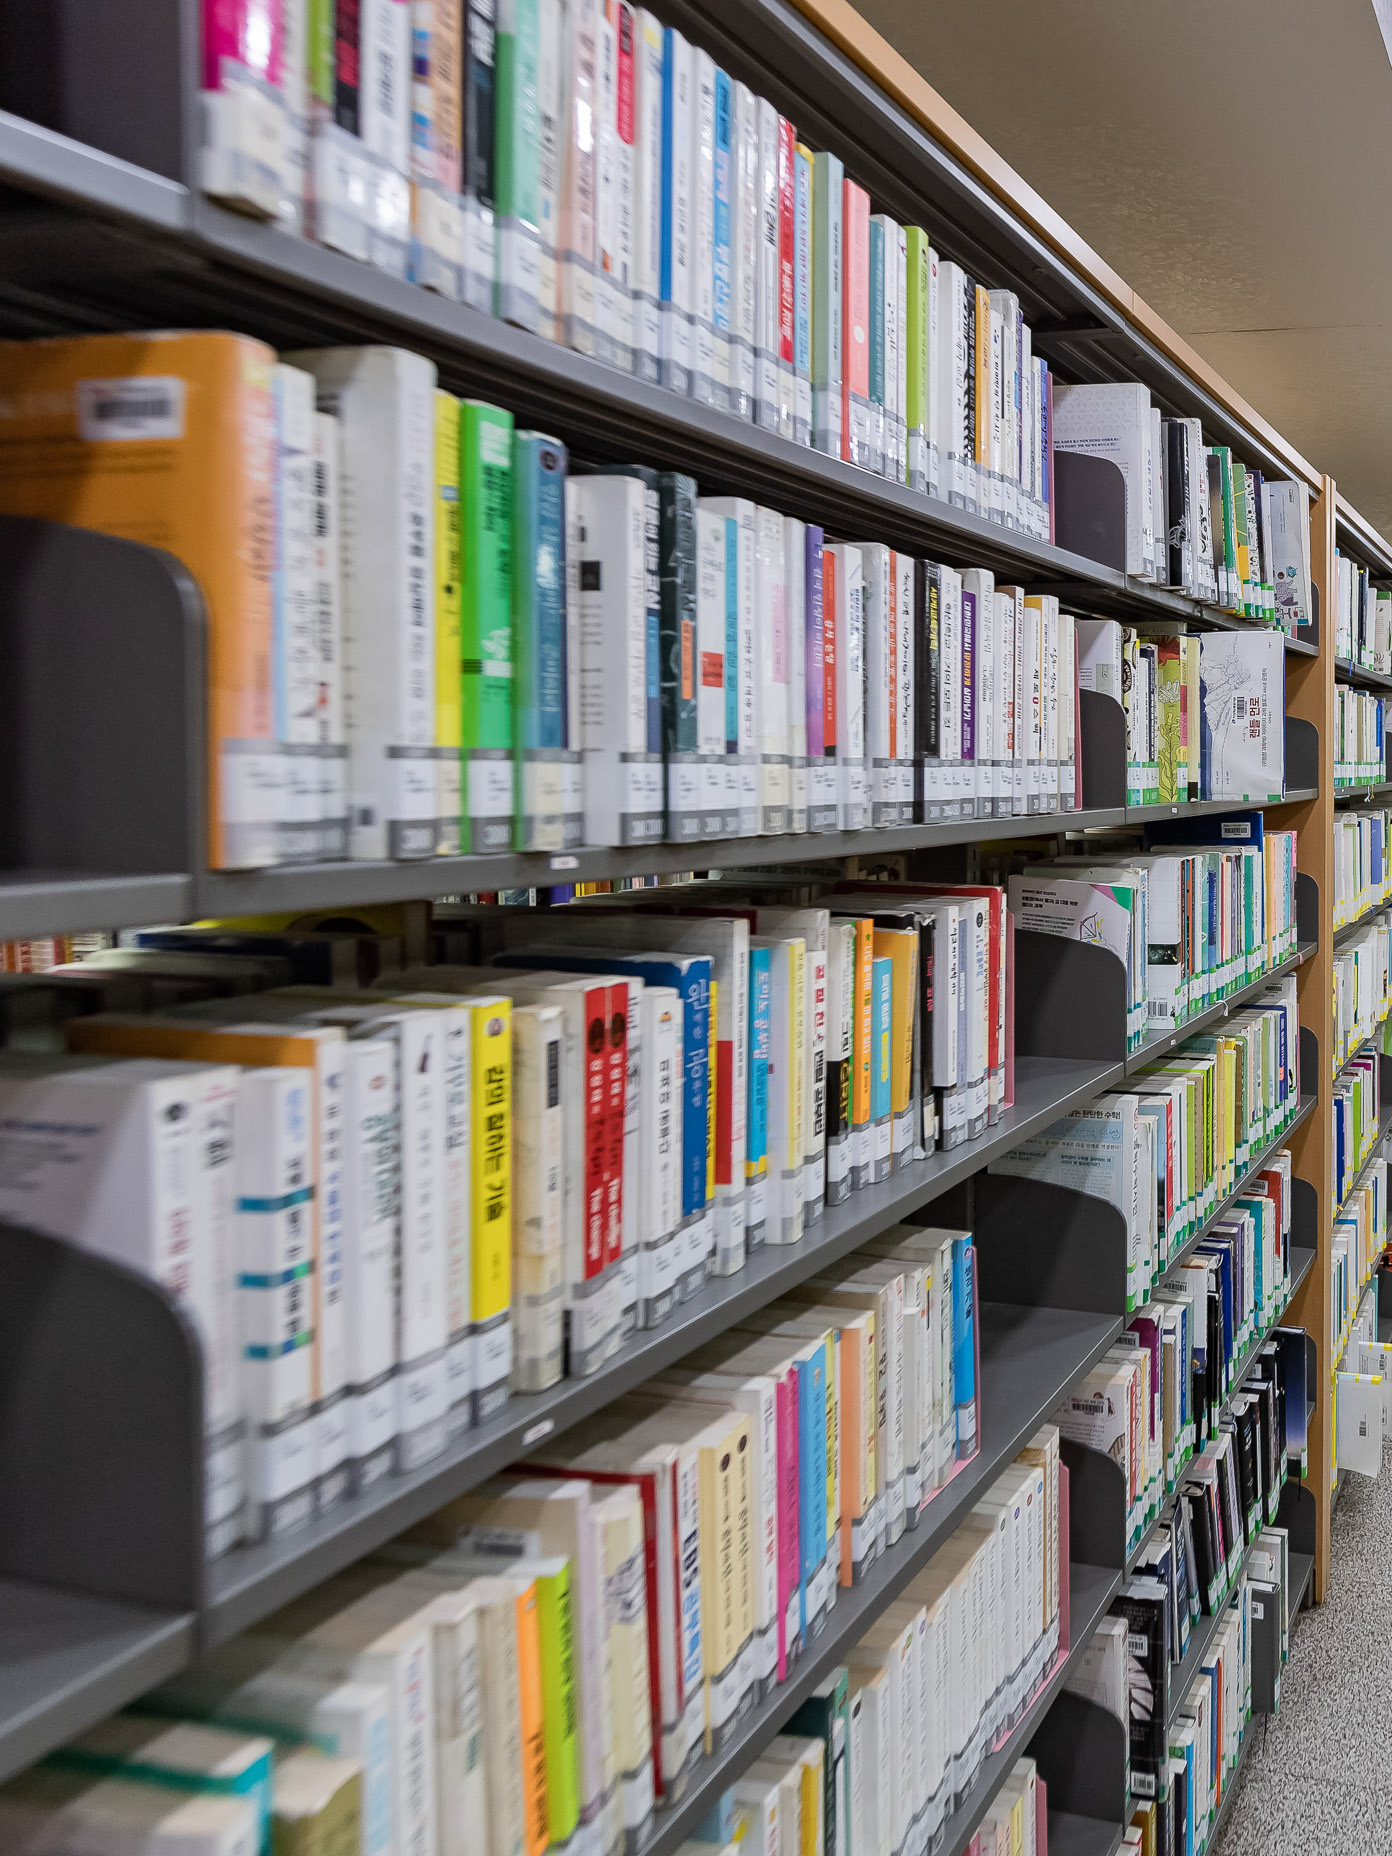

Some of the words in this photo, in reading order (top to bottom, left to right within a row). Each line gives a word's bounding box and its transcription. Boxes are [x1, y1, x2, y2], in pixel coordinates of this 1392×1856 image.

[963, 687, 972, 720] 살아남기
[1250, 697, 1260, 717] 먼로
[1250, 719, 1260, 739] 랜들
[839, 1060, 850, 1122] GRIT
[1083, 1110, 1104, 1119] 탄탄한
[1104, 1111, 1121, 1120] 수학!
